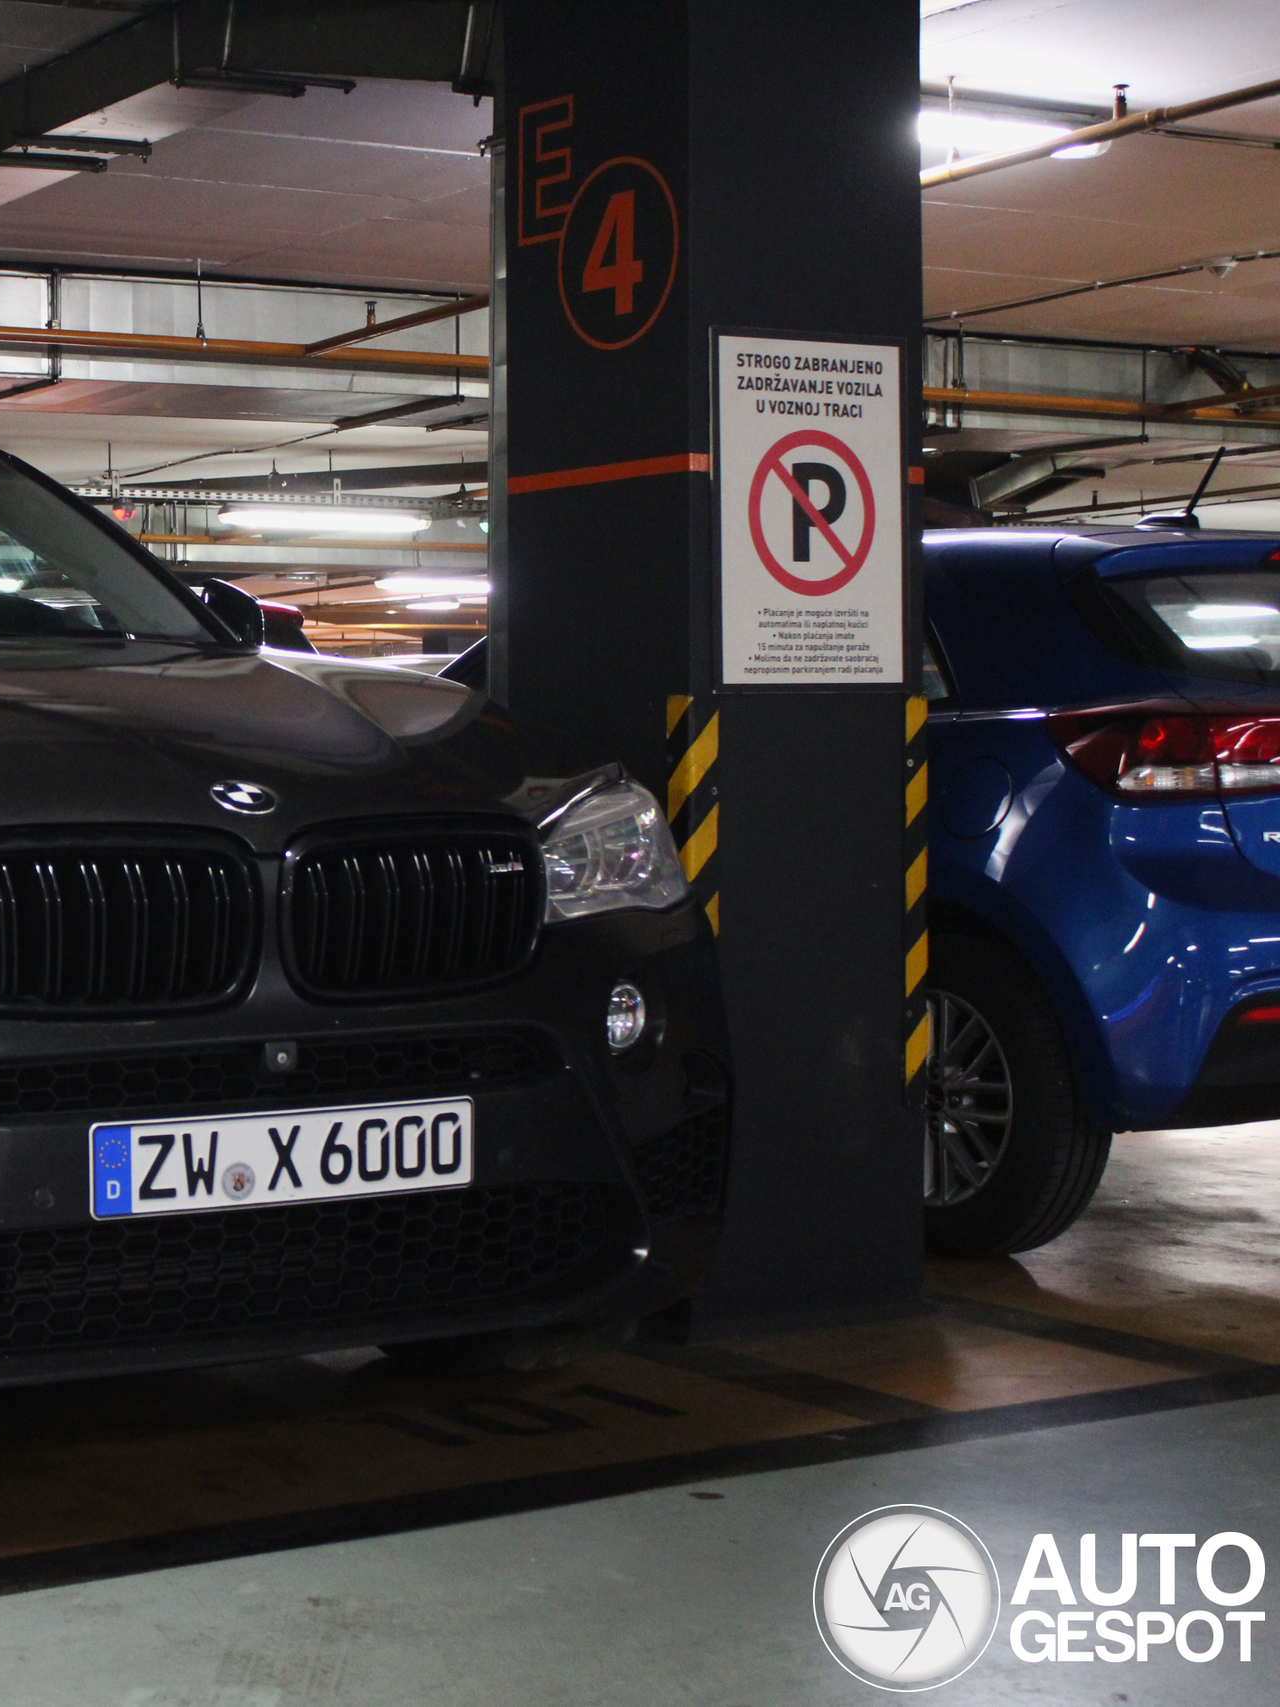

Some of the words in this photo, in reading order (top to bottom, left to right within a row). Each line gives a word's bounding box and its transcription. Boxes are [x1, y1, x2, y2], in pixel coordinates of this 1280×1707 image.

[518, 94, 573, 246] E
[582, 190, 643, 315] 4
[736, 353, 791, 370] STROGO
[794, 356, 883, 375] ZABRANJENO
[737, 373, 833, 395] ZADRŽAVANJE
[836, 381, 883, 397] VOZILA
[756, 399, 765, 414] U
[769, 400, 820, 416] VOZNOJ
[823, 403, 863, 418] TRACI
[795, 608, 803, 618] je
[804, 608, 833, 618] moguće
[758, 620, 802, 628] automatima
[812, 620, 846, 630] naplatnoj
[778, 631, 802, 640] Nakon
[834, 631, 855, 640] imate
[757, 642, 766, 651] 15
[767, 642, 793, 651] minuta
[804, 642, 844, 653] napuštanje
[845, 642, 870, 653] garaže
[754, 654, 781, 662] Molimo
[783, 654, 792, 662] da
[804, 653, 843, 662] zadržavate
[743, 665, 790, 675] nepropisnim
[791, 665, 836, 675] parkiranjem
[837, 665, 852, 674] radi
[138, 1130, 219, 1201] ZW
[267, 1124, 303, 1192] X
[319, 1112, 462, 1185] 6000
[106, 1180, 121, 1200] D
